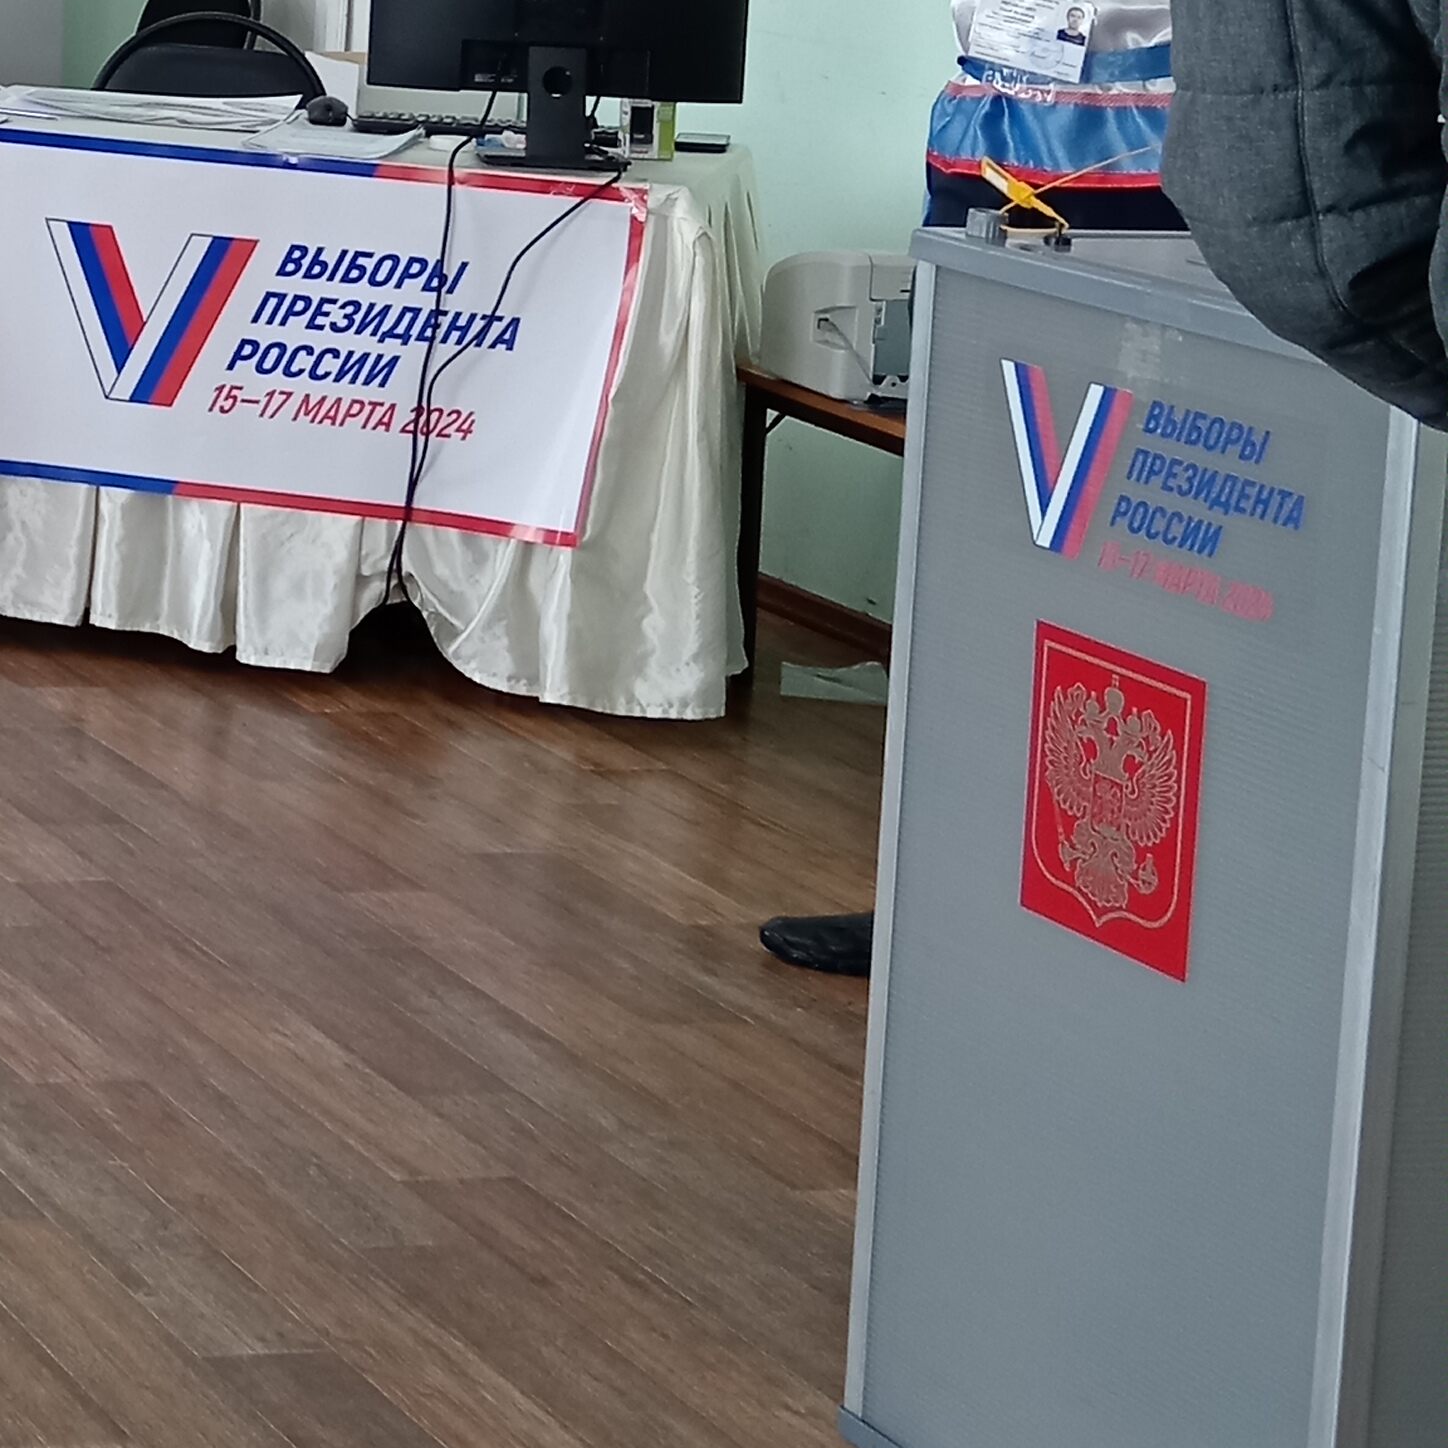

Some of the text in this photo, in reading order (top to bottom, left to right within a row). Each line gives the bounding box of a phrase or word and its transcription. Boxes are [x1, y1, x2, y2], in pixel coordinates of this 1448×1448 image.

[275, 243, 470, 295] ВЫБОРЫ
[250, 290, 521, 352] ПРЕЗИДЕНТА
[225, 337, 402, 389] РОССИИ
[291, 393, 398, 433] МАРТА
[399, 404, 477, 442] 2024
[1142, 398, 1272, 466] ВЫБОРЫ
[1126, 446, 1306, 532] ПРЕЗИДЕНТА
[1109, 493, 1224, 559] РОССИИ
